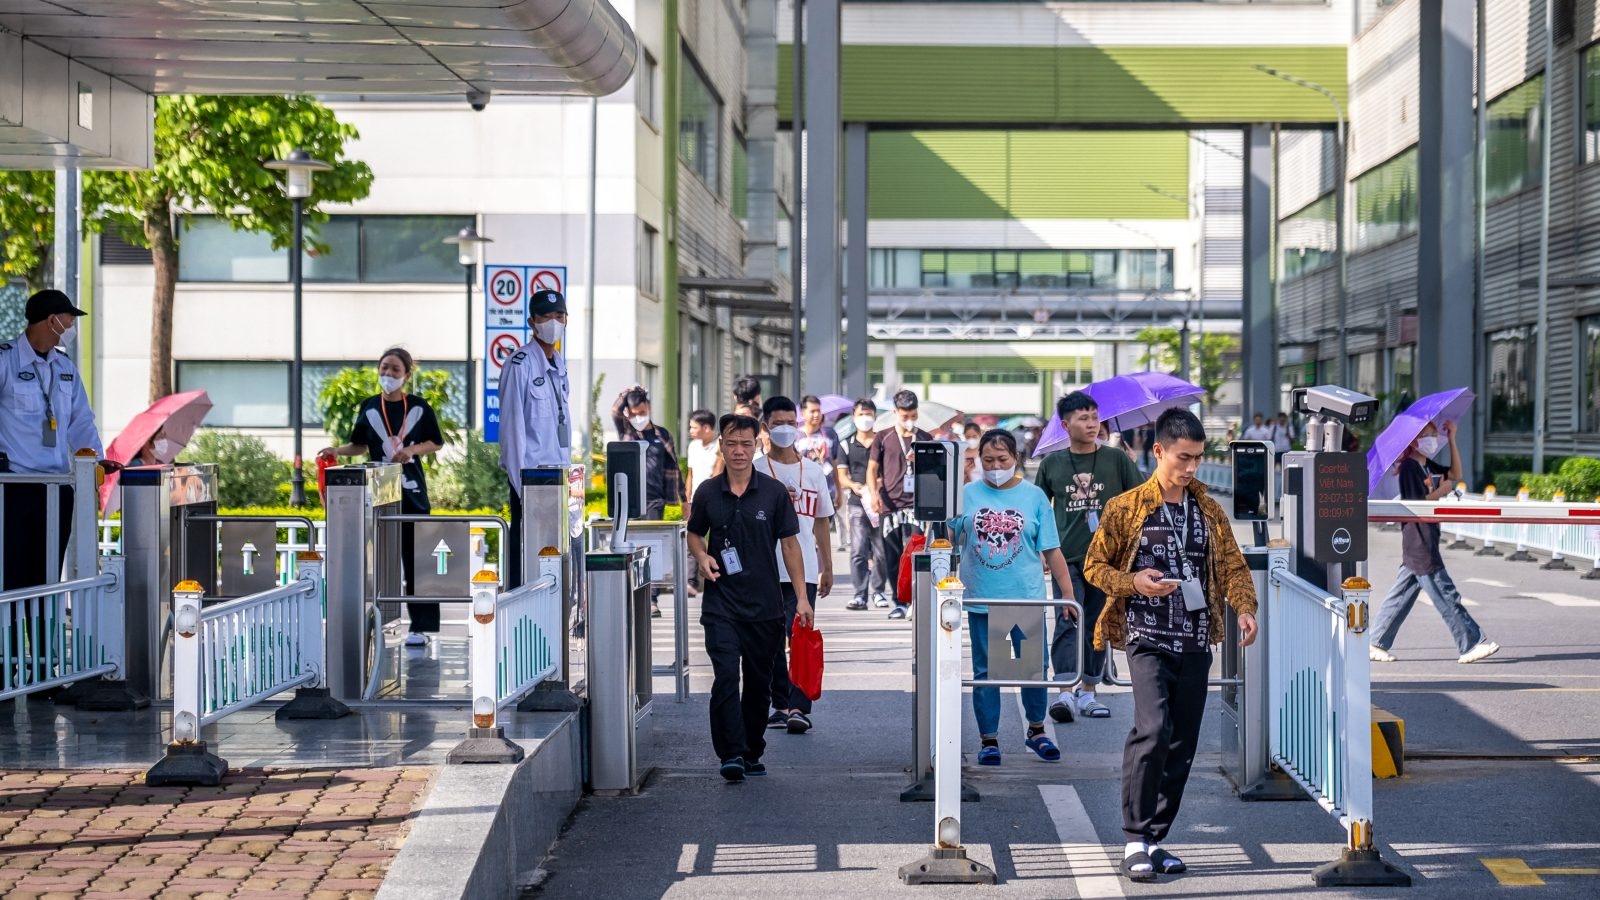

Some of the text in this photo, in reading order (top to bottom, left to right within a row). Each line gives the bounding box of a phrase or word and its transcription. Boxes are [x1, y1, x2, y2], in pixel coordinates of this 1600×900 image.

[497, 279, 515, 296] 20
[1319, 465, 1349, 473] Goertek
[1065, 482, 1105, 493] 18 90
[1337, 480, 1353, 488] Nam
[1319, 494, 1353, 502] 23-07-13
[792, 491, 818, 516] NT
[1319, 508, 1353, 517] 08:09:47
